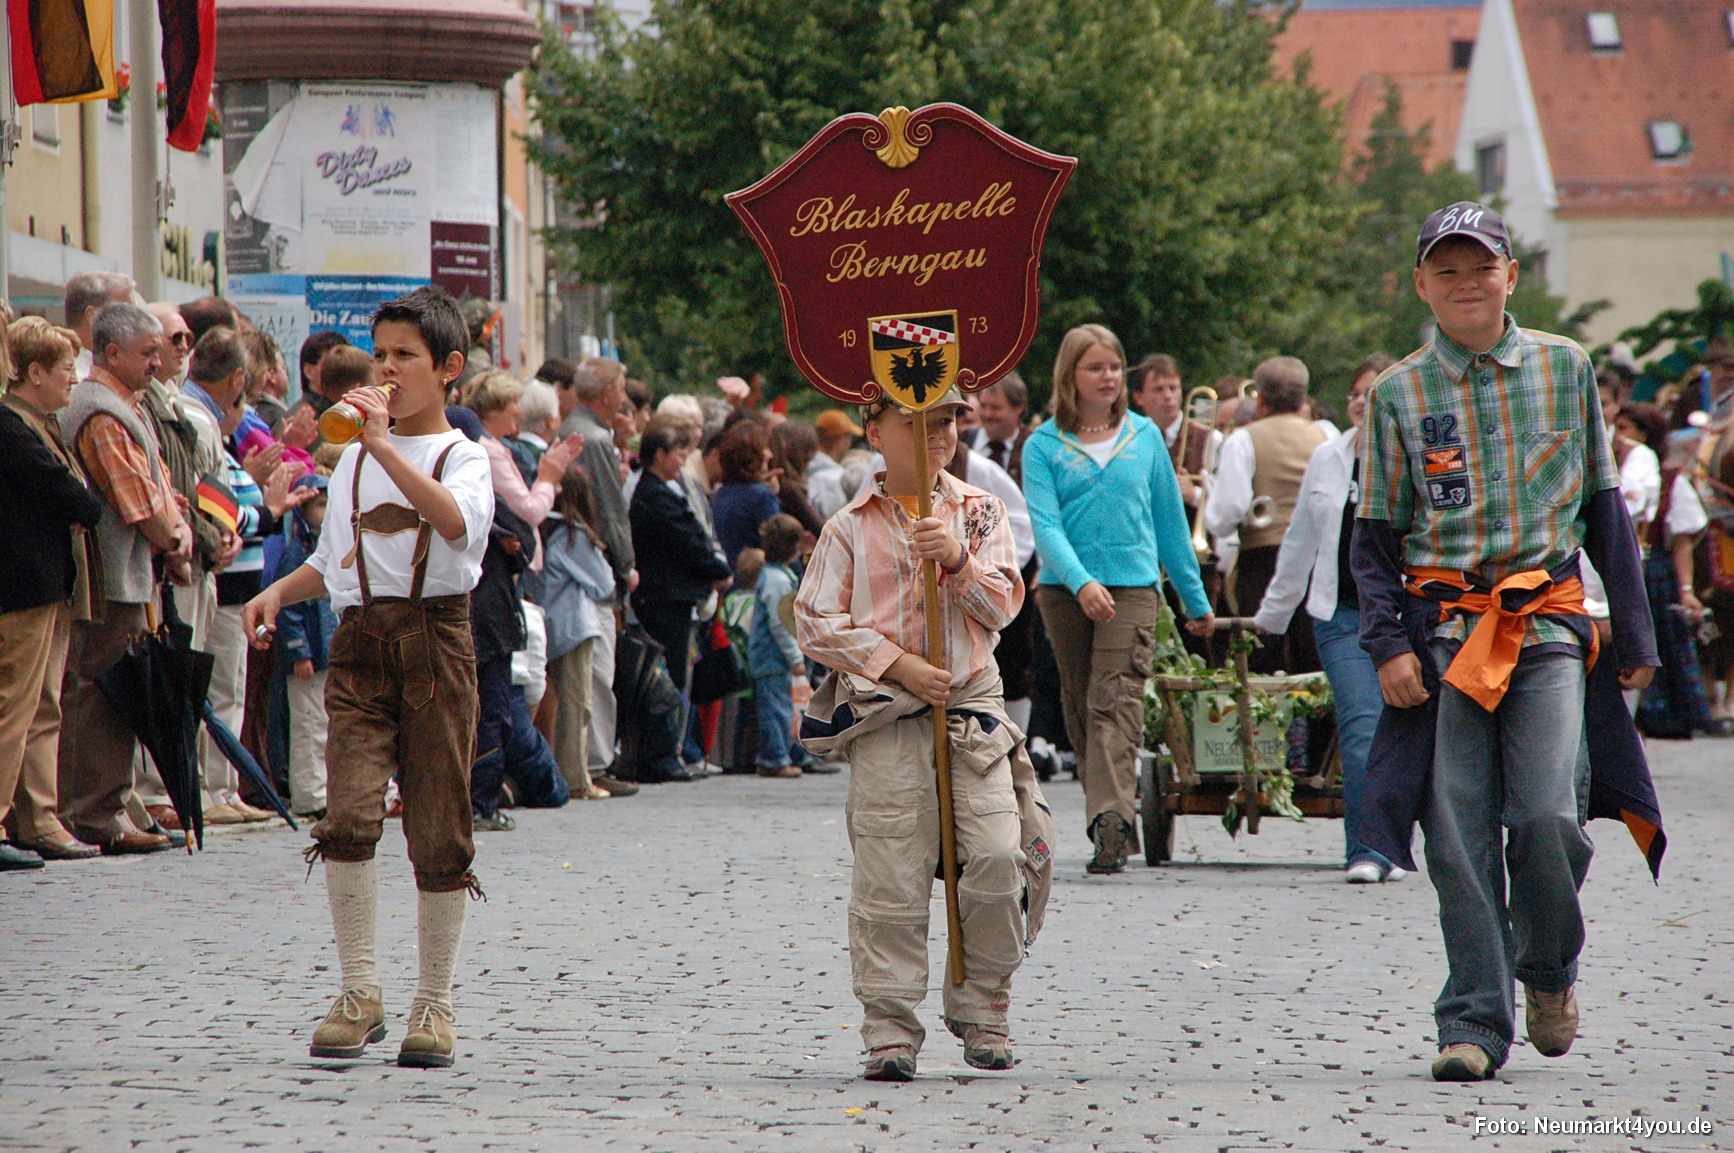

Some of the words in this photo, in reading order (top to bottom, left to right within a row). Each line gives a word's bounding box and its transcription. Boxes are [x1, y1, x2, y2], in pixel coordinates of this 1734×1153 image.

[790, 181, 1017, 237] Blaskapelle
[1437, 208, 1485, 234] BM
[826, 240, 986, 287] Berngau
[311, 310, 337, 326] Die
[838, 329, 857, 348] 19
[968, 317, 989, 334] 73
[1421, 413, 1461, 447] 92
